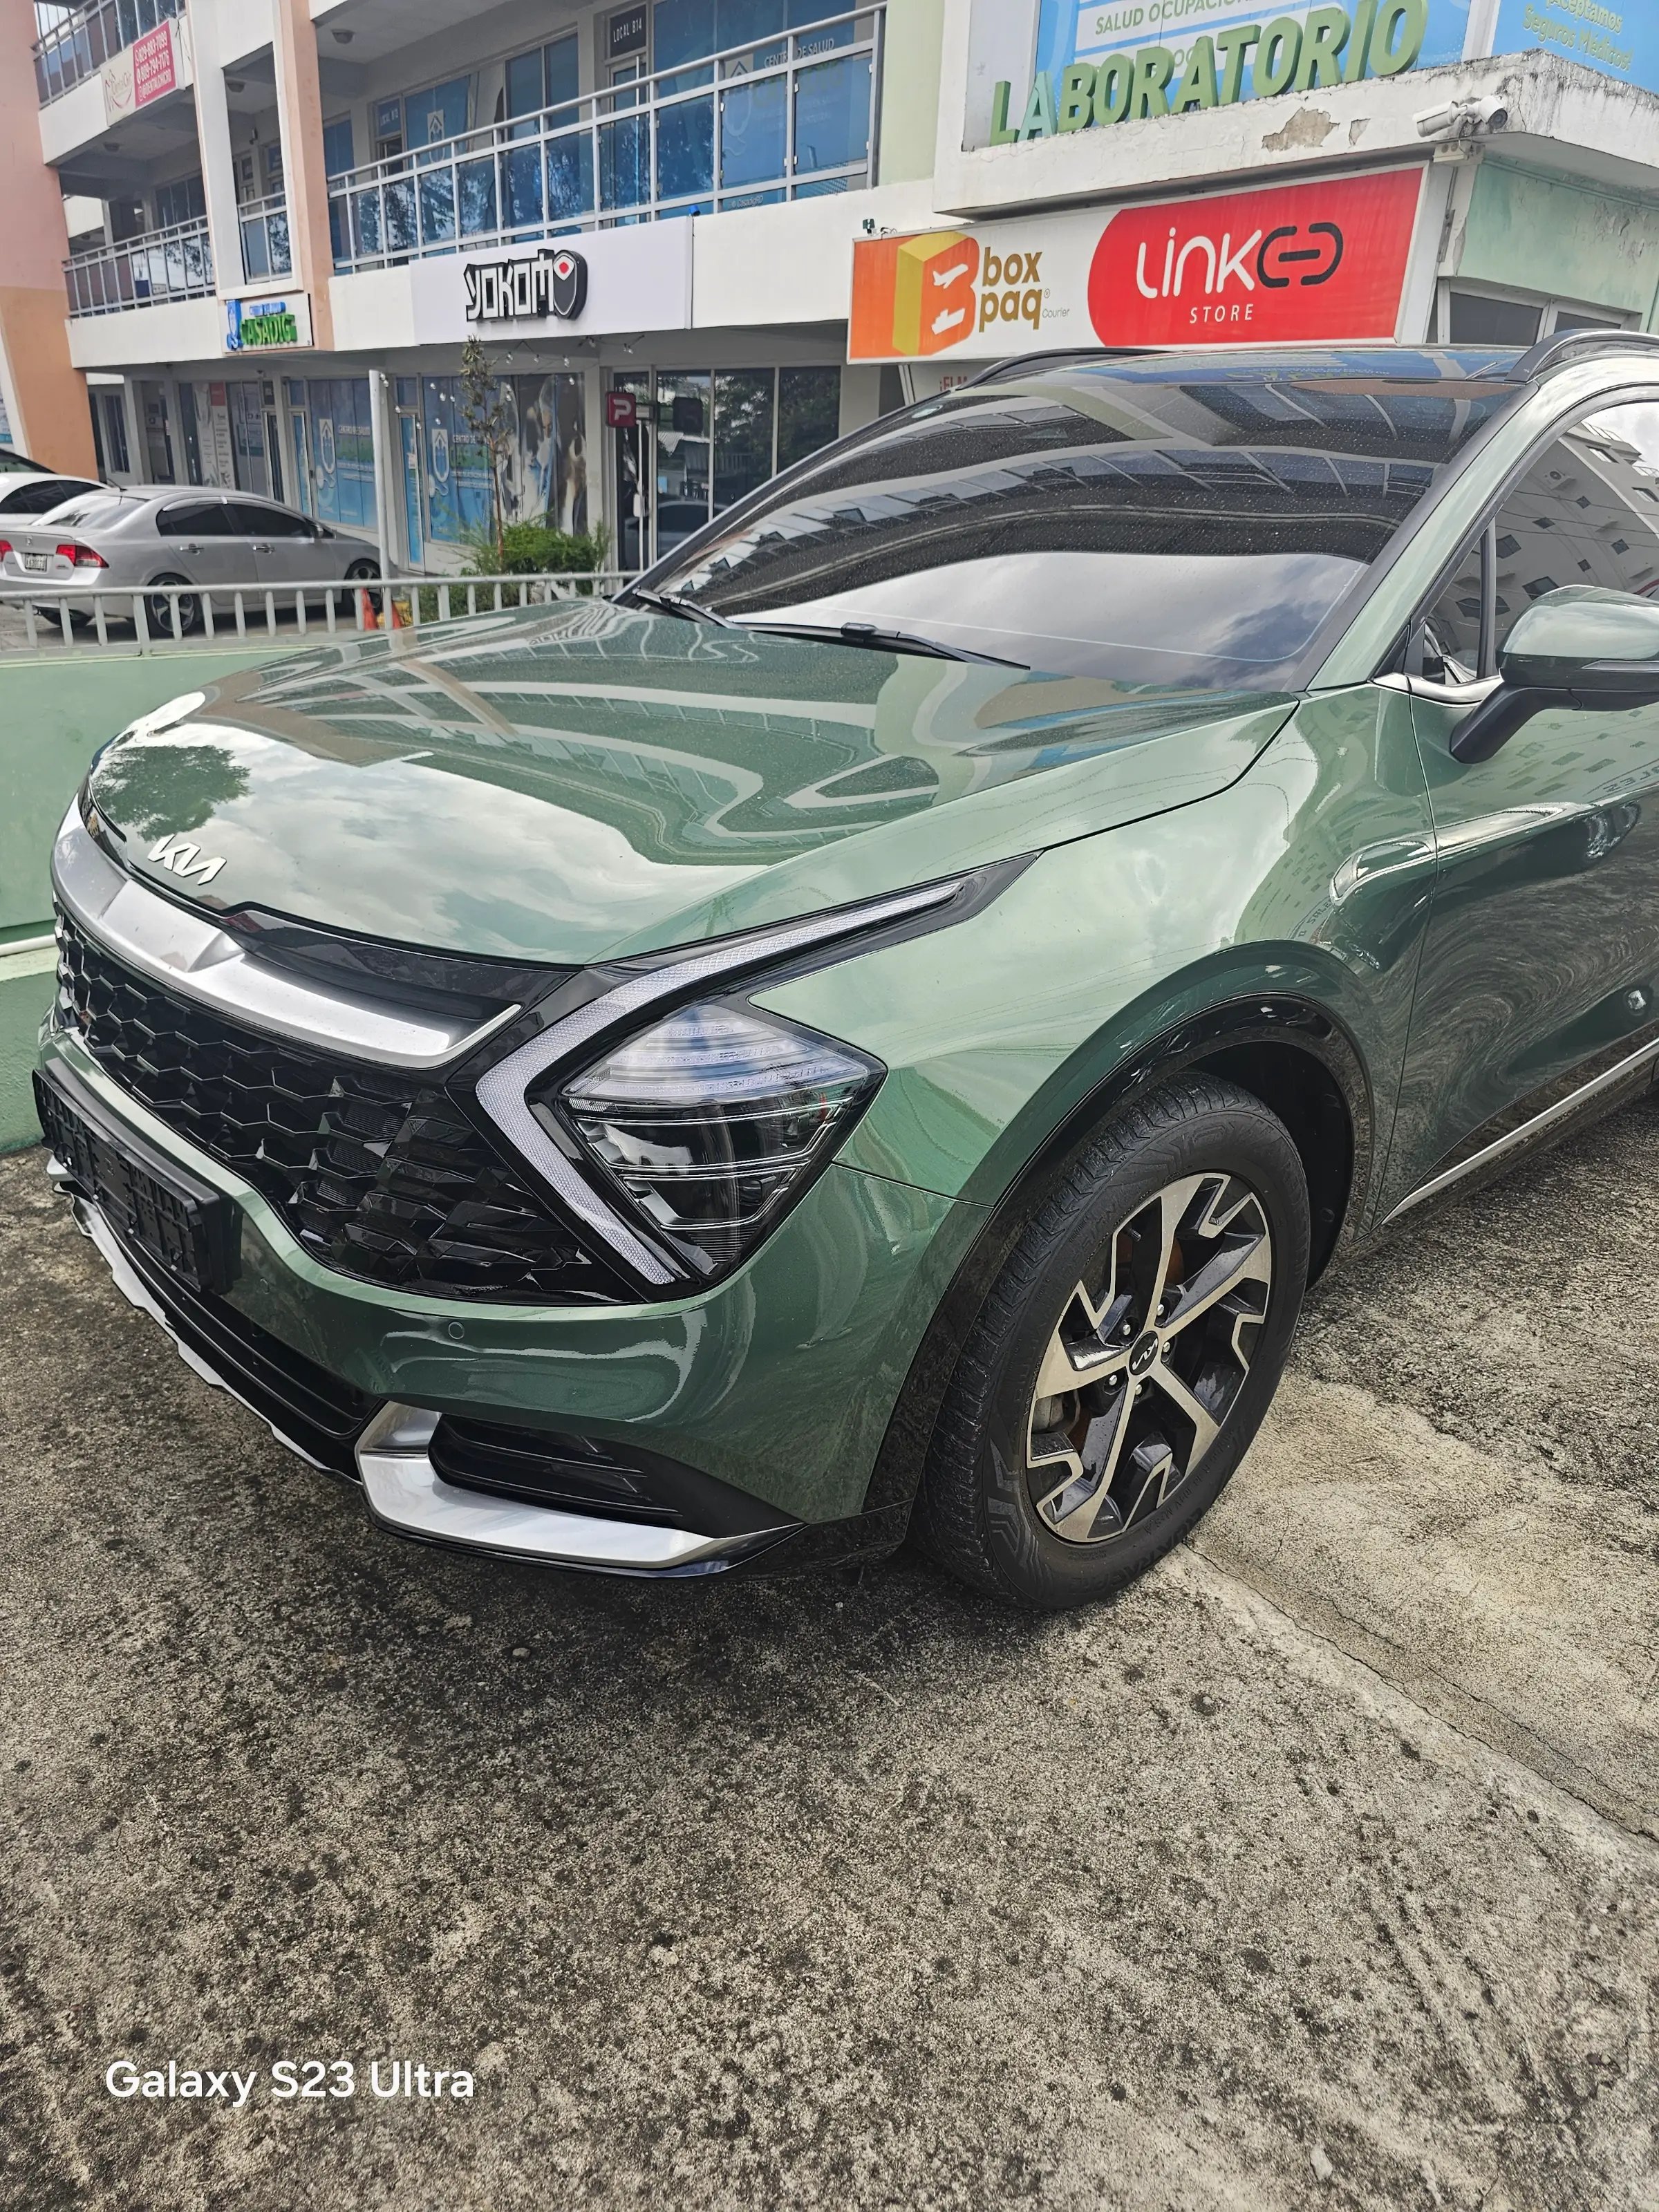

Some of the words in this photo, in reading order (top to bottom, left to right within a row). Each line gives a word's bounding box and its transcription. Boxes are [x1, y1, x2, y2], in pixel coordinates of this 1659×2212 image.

[613, 23, 630, 43] LOCAL
[1096, 7, 1144, 35] SALUD
[1148, 0, 1244, 22] OCUPAC
[1523, 3, 1577, 48] Seguros
[765, 51, 788, 68] CENTR
[797, 47, 807, 59] DE
[808, 38, 834, 57] SALUD
[991, 0, 1429, 147] LABORATORIO
[982, 246, 1042, 287] box
[979, 289, 1042, 332] paq
[1042, 308, 1071, 319] Courier
[1189, 303, 1254, 324] STORE
[240, 314, 298, 346] CASADIG
[147, 834, 227, 885] KIA
